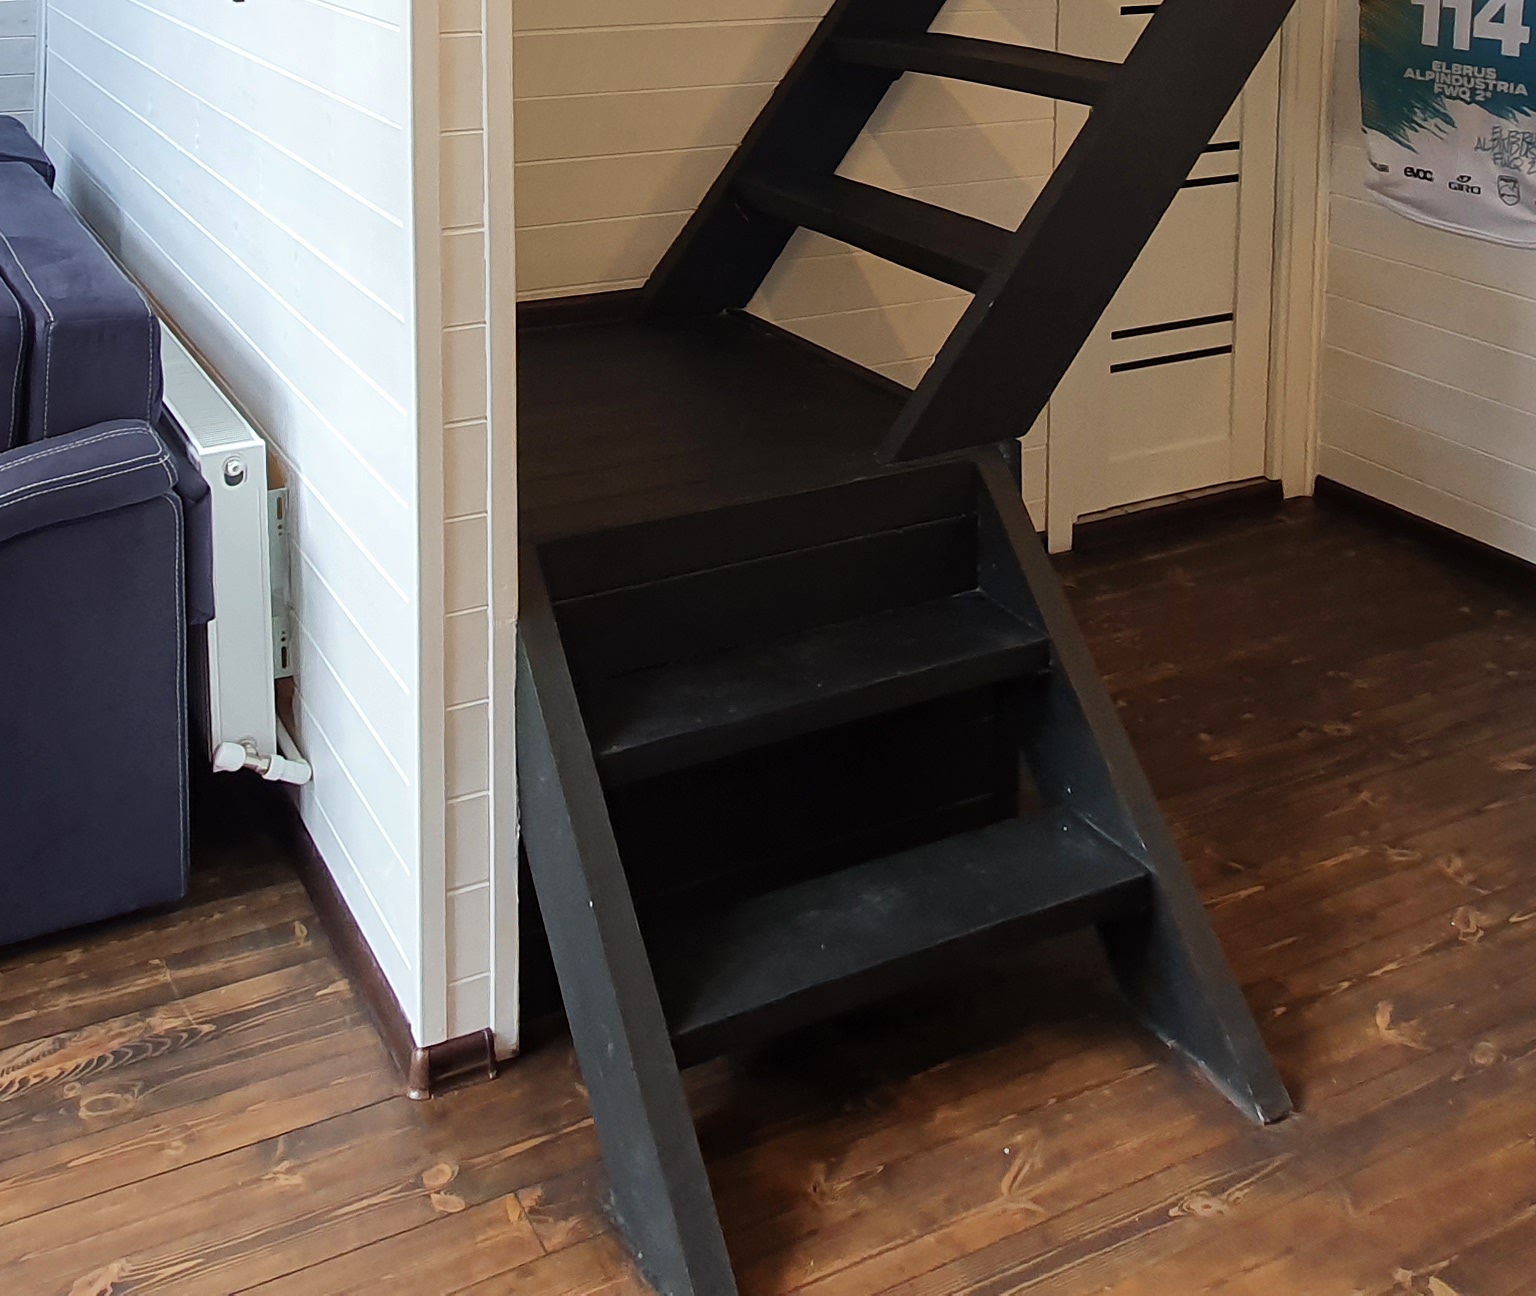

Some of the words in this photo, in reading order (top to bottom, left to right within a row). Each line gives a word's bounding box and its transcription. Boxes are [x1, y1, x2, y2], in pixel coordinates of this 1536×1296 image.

[1431, 60, 1497, 80] ELBRUS
[1403, 67, 1528, 96] ALPINDUSTRIA
[1434, 82, 1471, 102] FWQ
[1448, 182, 1482, 195] GIRO
